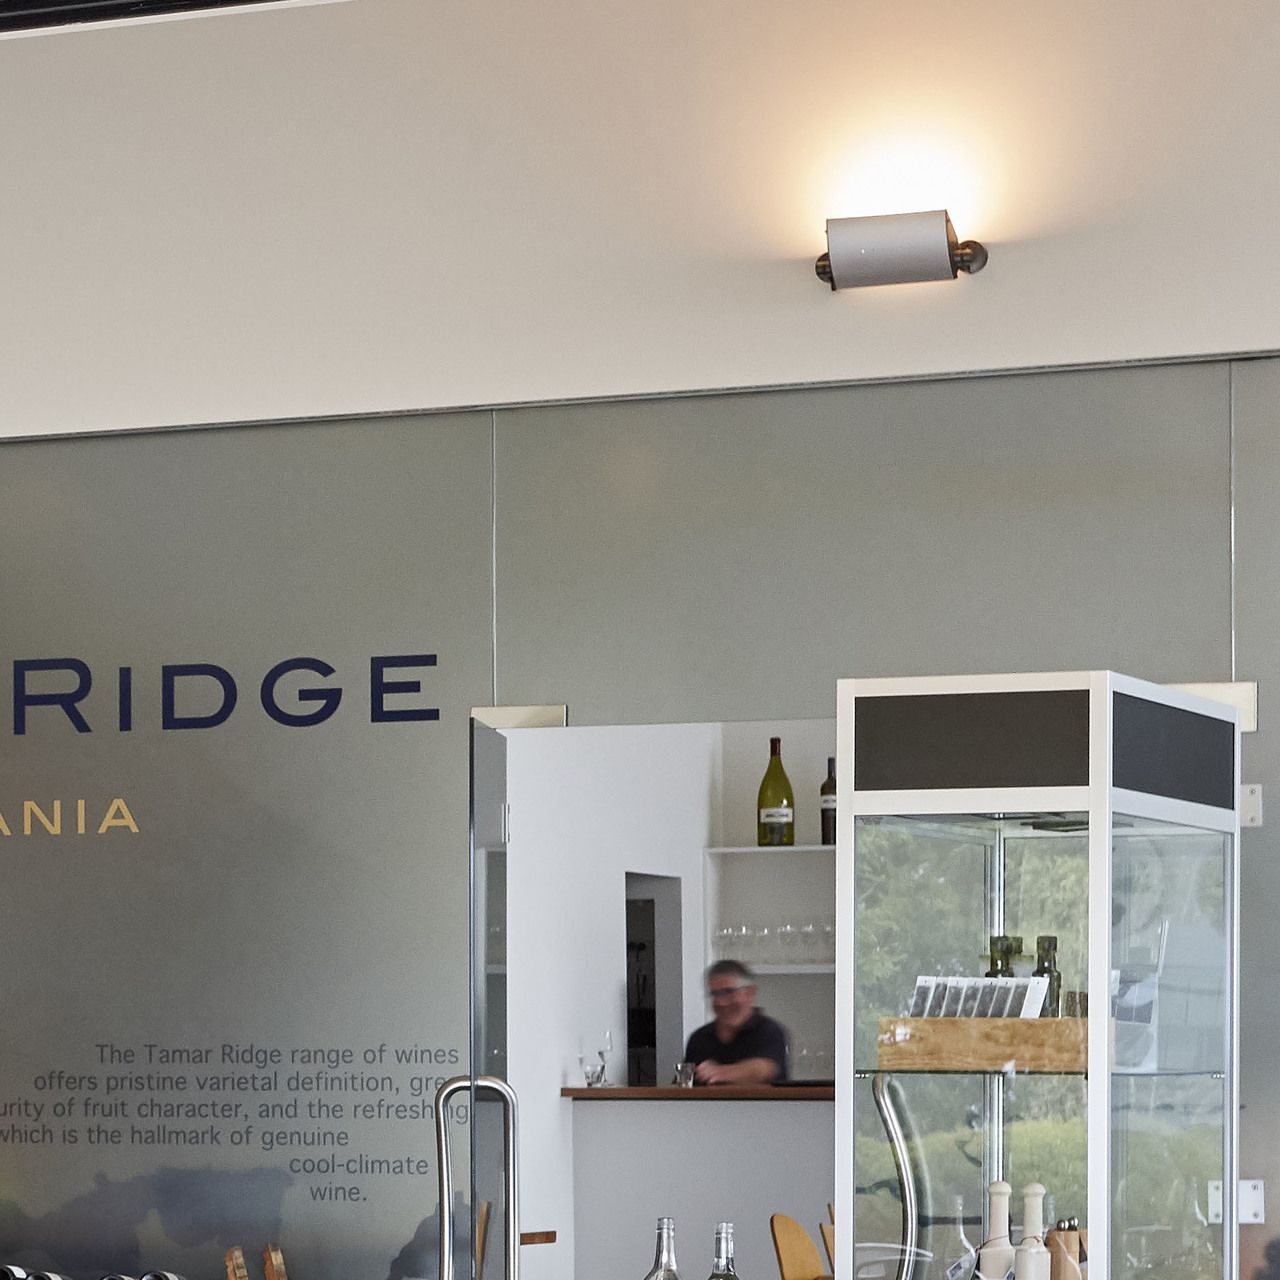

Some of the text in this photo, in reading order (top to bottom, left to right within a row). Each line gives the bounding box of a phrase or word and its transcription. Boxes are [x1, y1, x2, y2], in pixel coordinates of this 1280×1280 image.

[13, 653, 440, 736] RIDGE
[95, 1043, 459, 1070] The Tamar Ridge range of wines
[33, 1071, 446, 1097] offers pristine varietal definition, gre
[52, 1097, 76, 1119] of
[83, 1097, 128, 1119] fruit
[136, 1097, 250, 1121] character,
[257, 1099, 299, 1120] and
[306, 1099, 345, 1120] the
[353, 1099, 469, 1125] refreshng
[62, 1126, 79, 1145] is
[86, 1125, 122, 1145] the
[130, 1125, 221, 1146] hallmark
[229, 1125, 254, 1146] of
[260, 1127, 349, 1151] genuine
[288, 1154, 429, 1176] cool-climate
[309, 1182, 368, 1203] wine.
